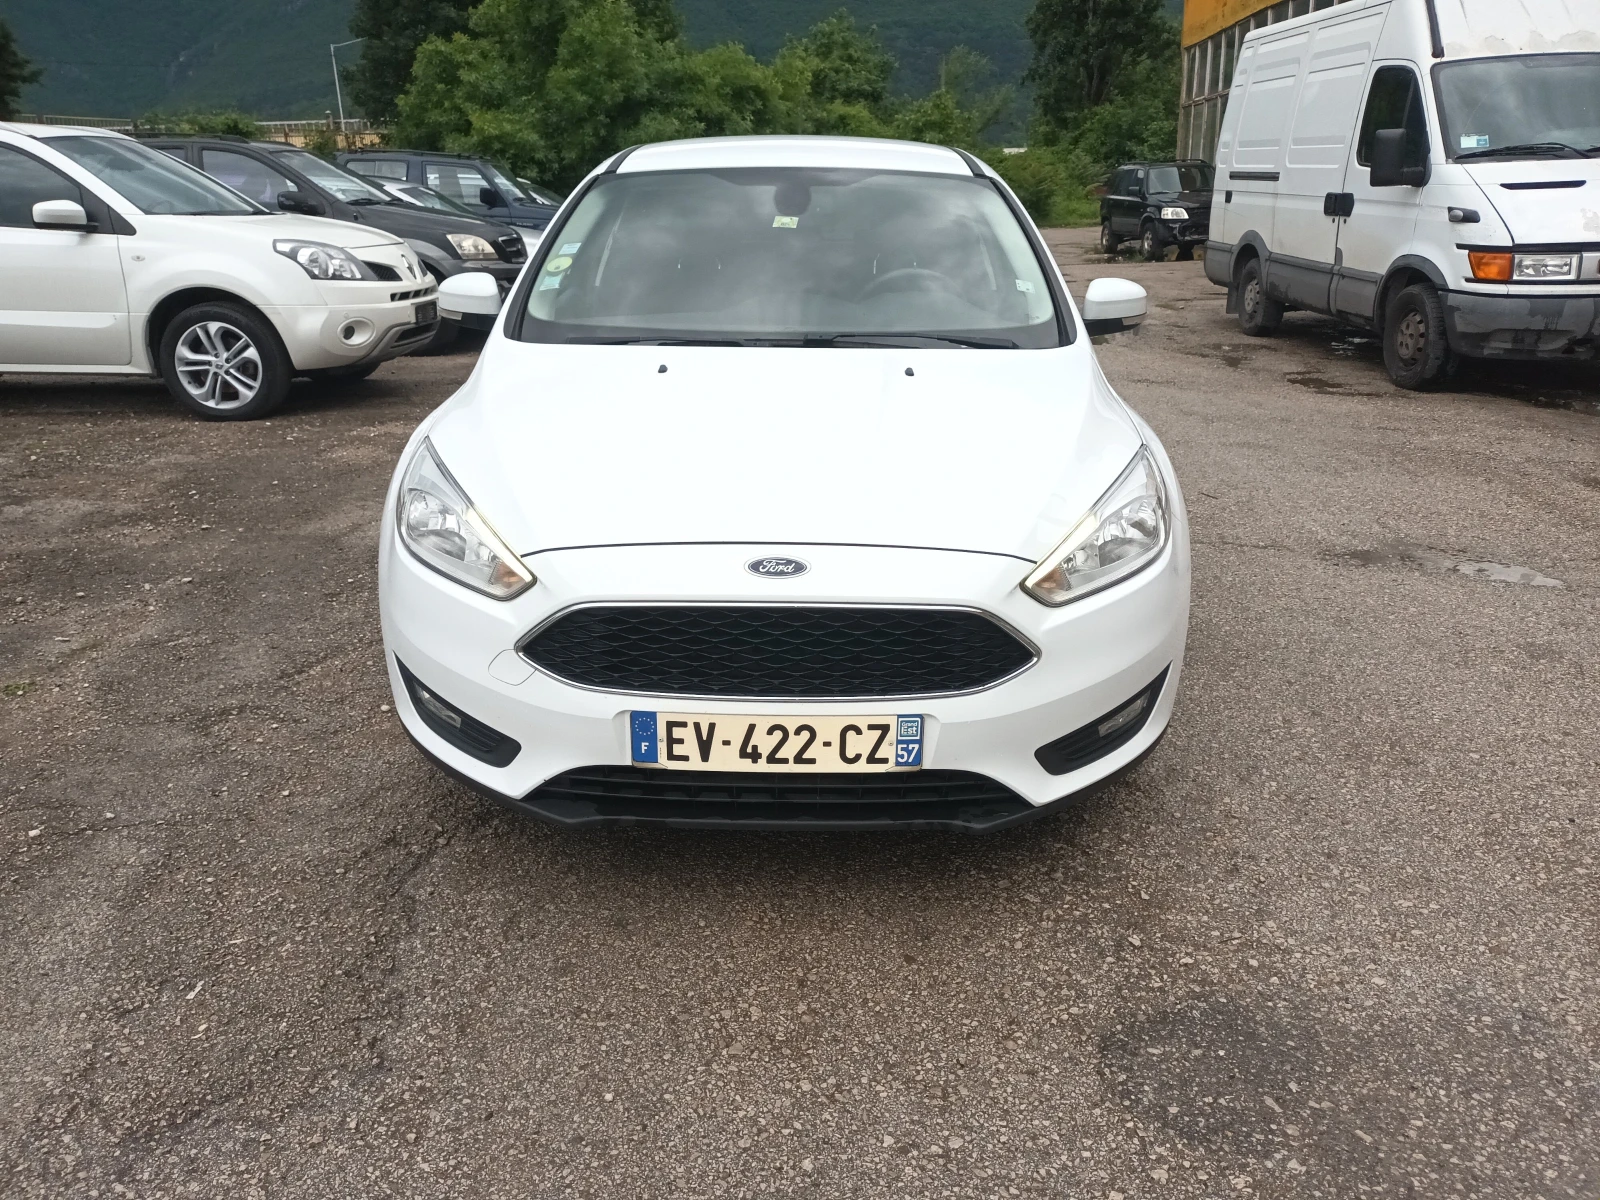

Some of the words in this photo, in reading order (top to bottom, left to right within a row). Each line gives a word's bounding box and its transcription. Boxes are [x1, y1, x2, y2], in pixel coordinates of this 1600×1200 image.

[759, 560, 796, 573] Ford
[901, 727, 918, 735] Est
[641, 742, 649, 754] F
[666, 720, 890, 764] EV-422-CZ
[897, 744, 920, 763] 57
